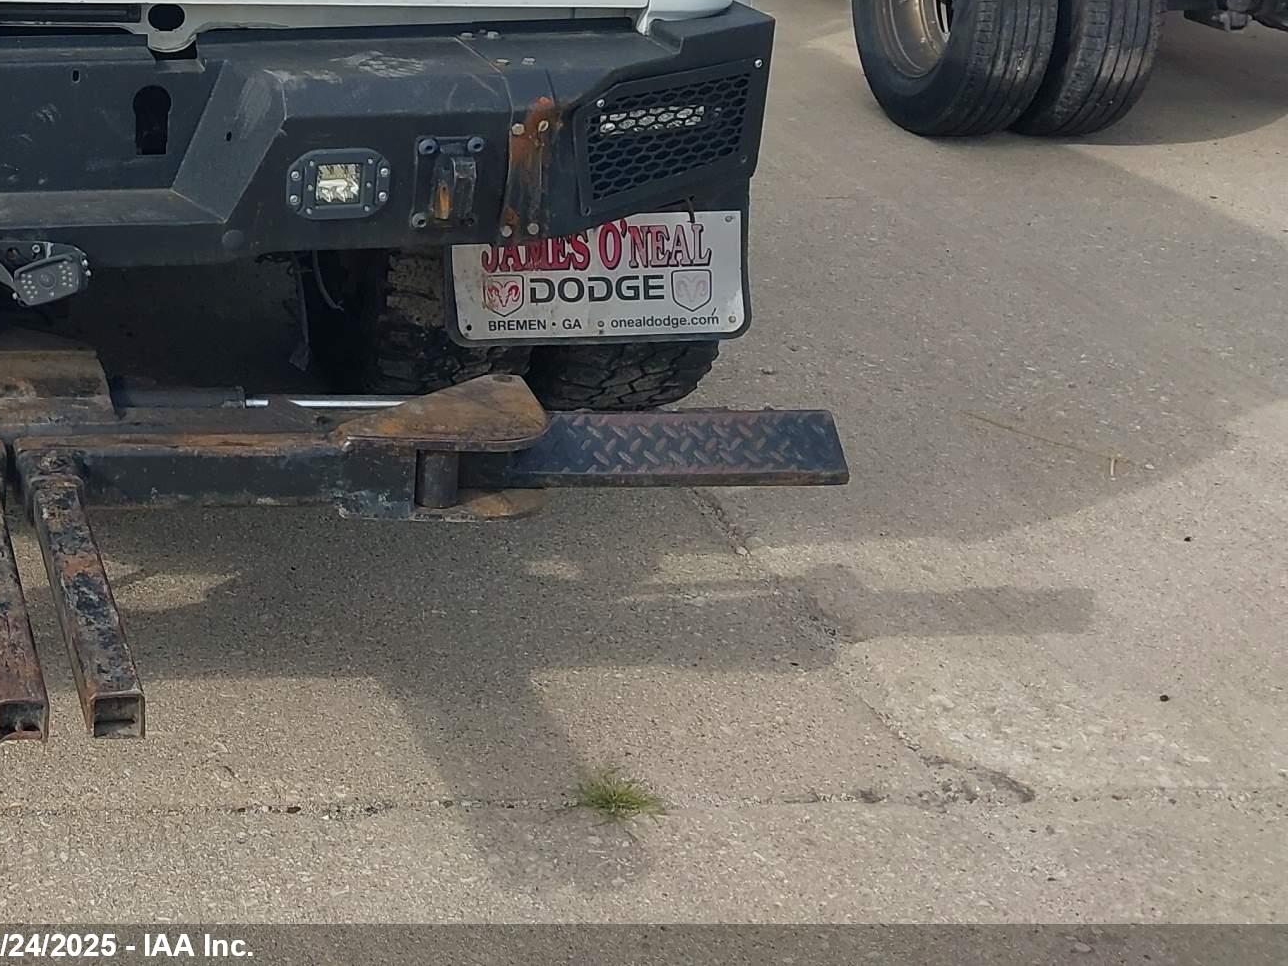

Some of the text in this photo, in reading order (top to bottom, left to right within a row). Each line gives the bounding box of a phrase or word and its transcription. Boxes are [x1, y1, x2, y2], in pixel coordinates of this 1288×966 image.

[481, 218, 713, 273] JAMES O'NEAL
[529, 274, 665, 304] DODGE
[487, 318, 583, 332] BREMEN GA
[610, 314, 720, 329] onealdodge.com
